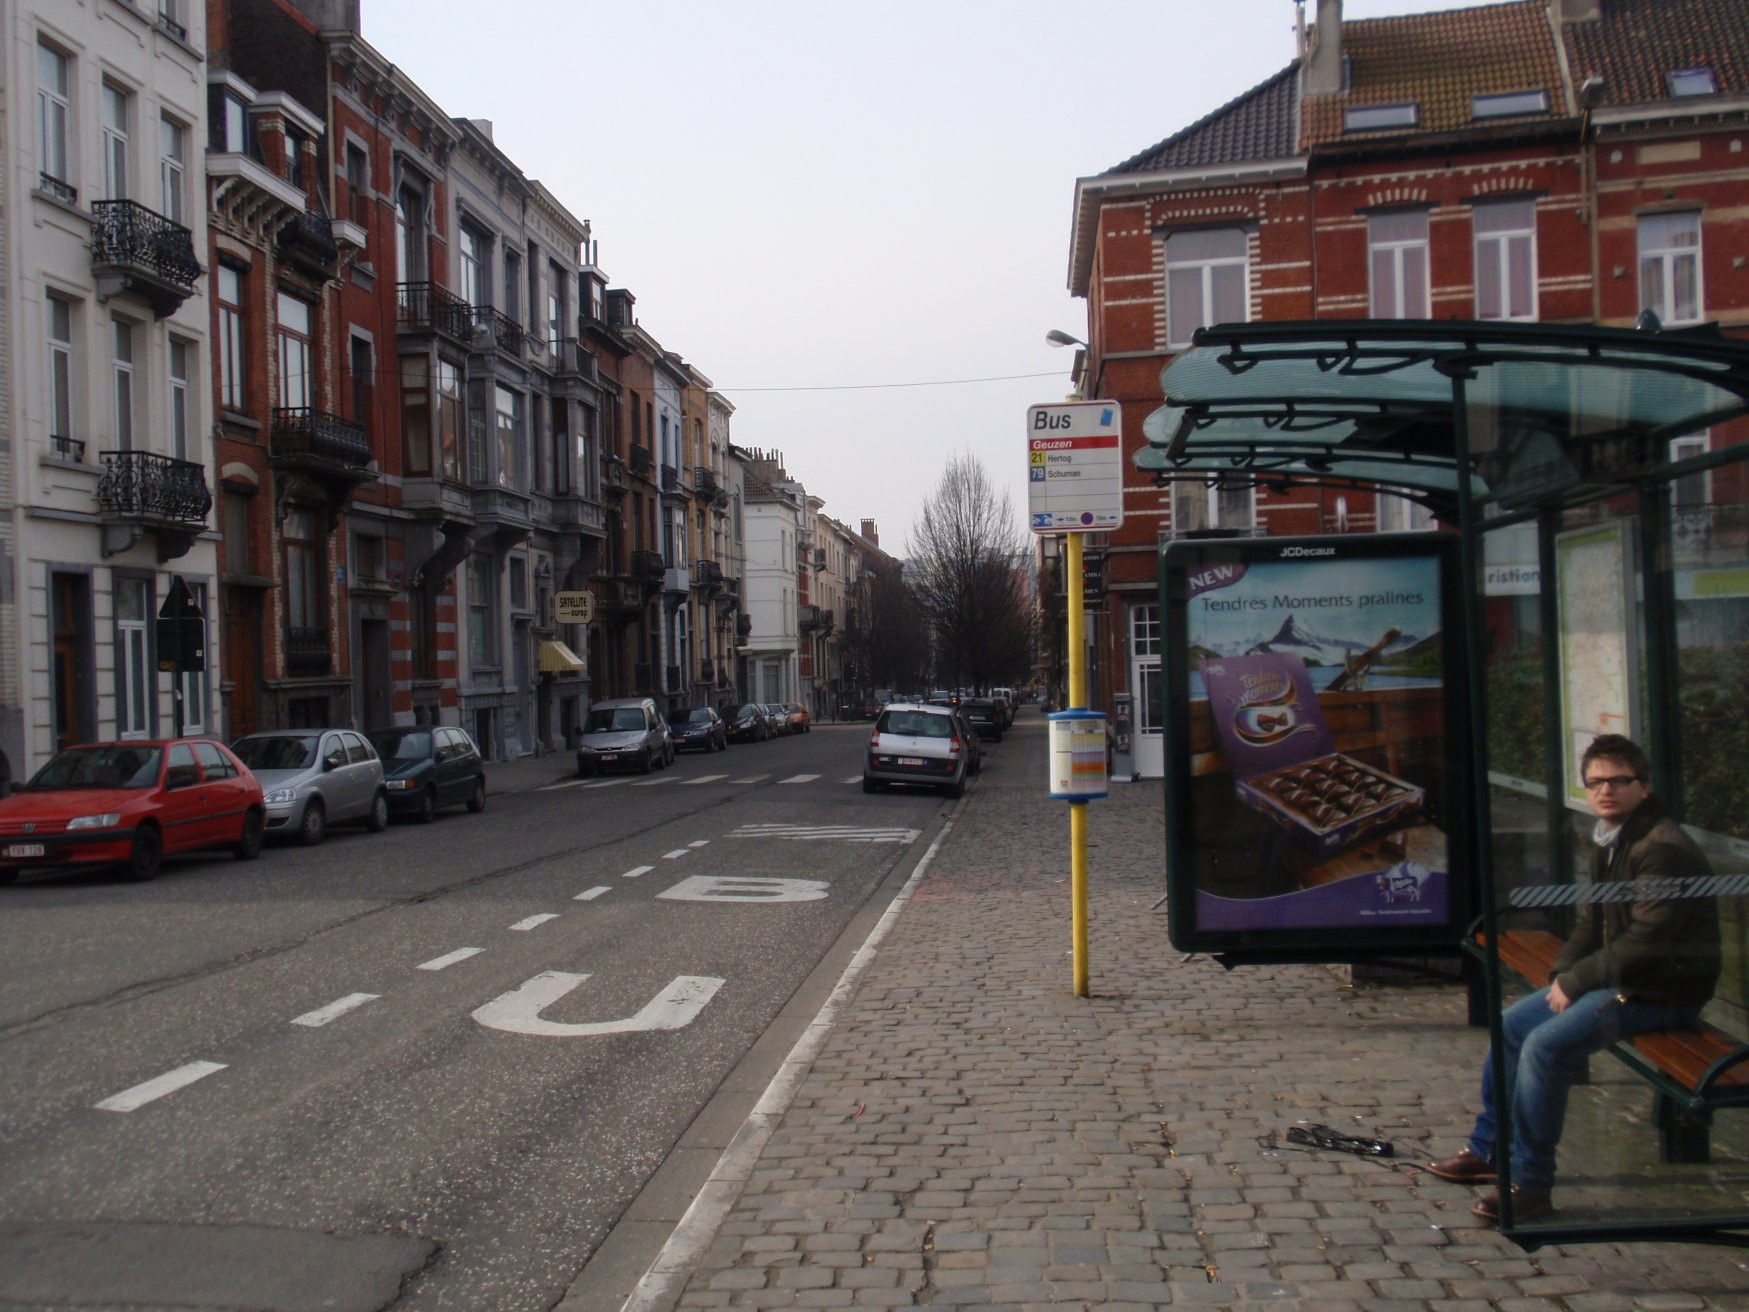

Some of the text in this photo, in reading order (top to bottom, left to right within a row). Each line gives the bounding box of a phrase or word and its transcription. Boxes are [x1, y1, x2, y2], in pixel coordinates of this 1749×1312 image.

[1034, 411, 1072, 430] Bus
[1033, 440, 1072, 450] Geuzen
[1031, 452, 1072, 463] 21 Hertog
[1031, 467, 1081, 479] 79 Schuman
[1280, 547, 1335, 557] JCDecaux
[1188, 565, 1234, 590] NEW
[559, 597, 587, 608] SATELLITE
[1201, 591, 1424, 611] Tendres Moments pralines
